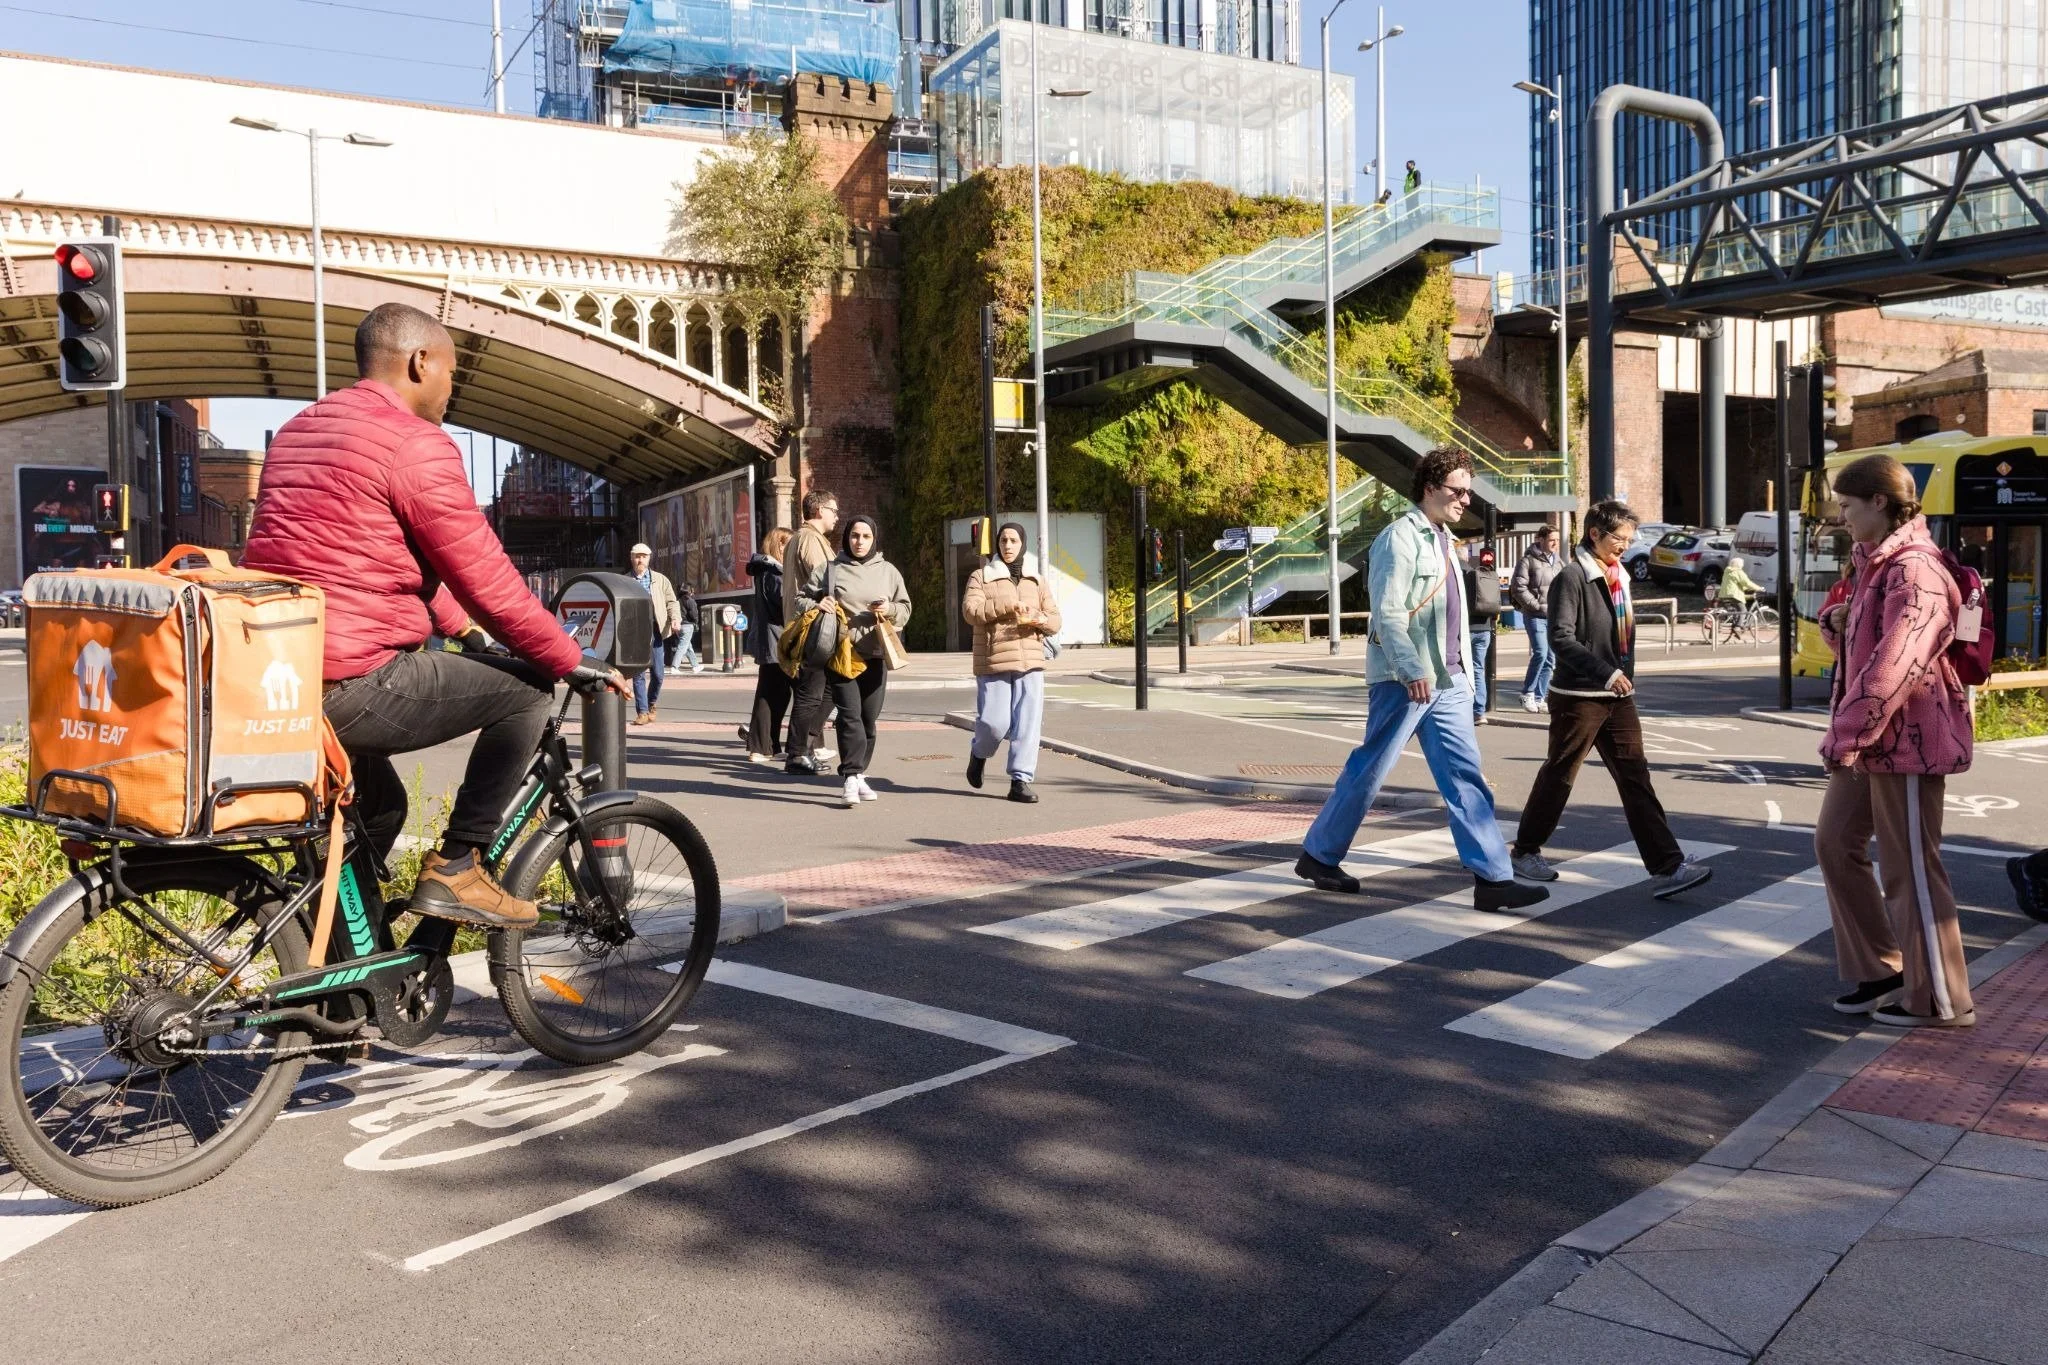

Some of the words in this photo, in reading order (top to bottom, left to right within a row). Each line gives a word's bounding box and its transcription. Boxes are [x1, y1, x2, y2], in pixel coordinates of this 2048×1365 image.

[34, 524, 47, 533] FOR
[60, 718, 97, 740] JUST
[99, 723, 129, 746] EAT
[243, 719, 286, 737] JUST
[287, 716, 314, 734] EAT
[488, 804, 527, 861] HITWAY
[339, 868, 360, 916] HITWAY
